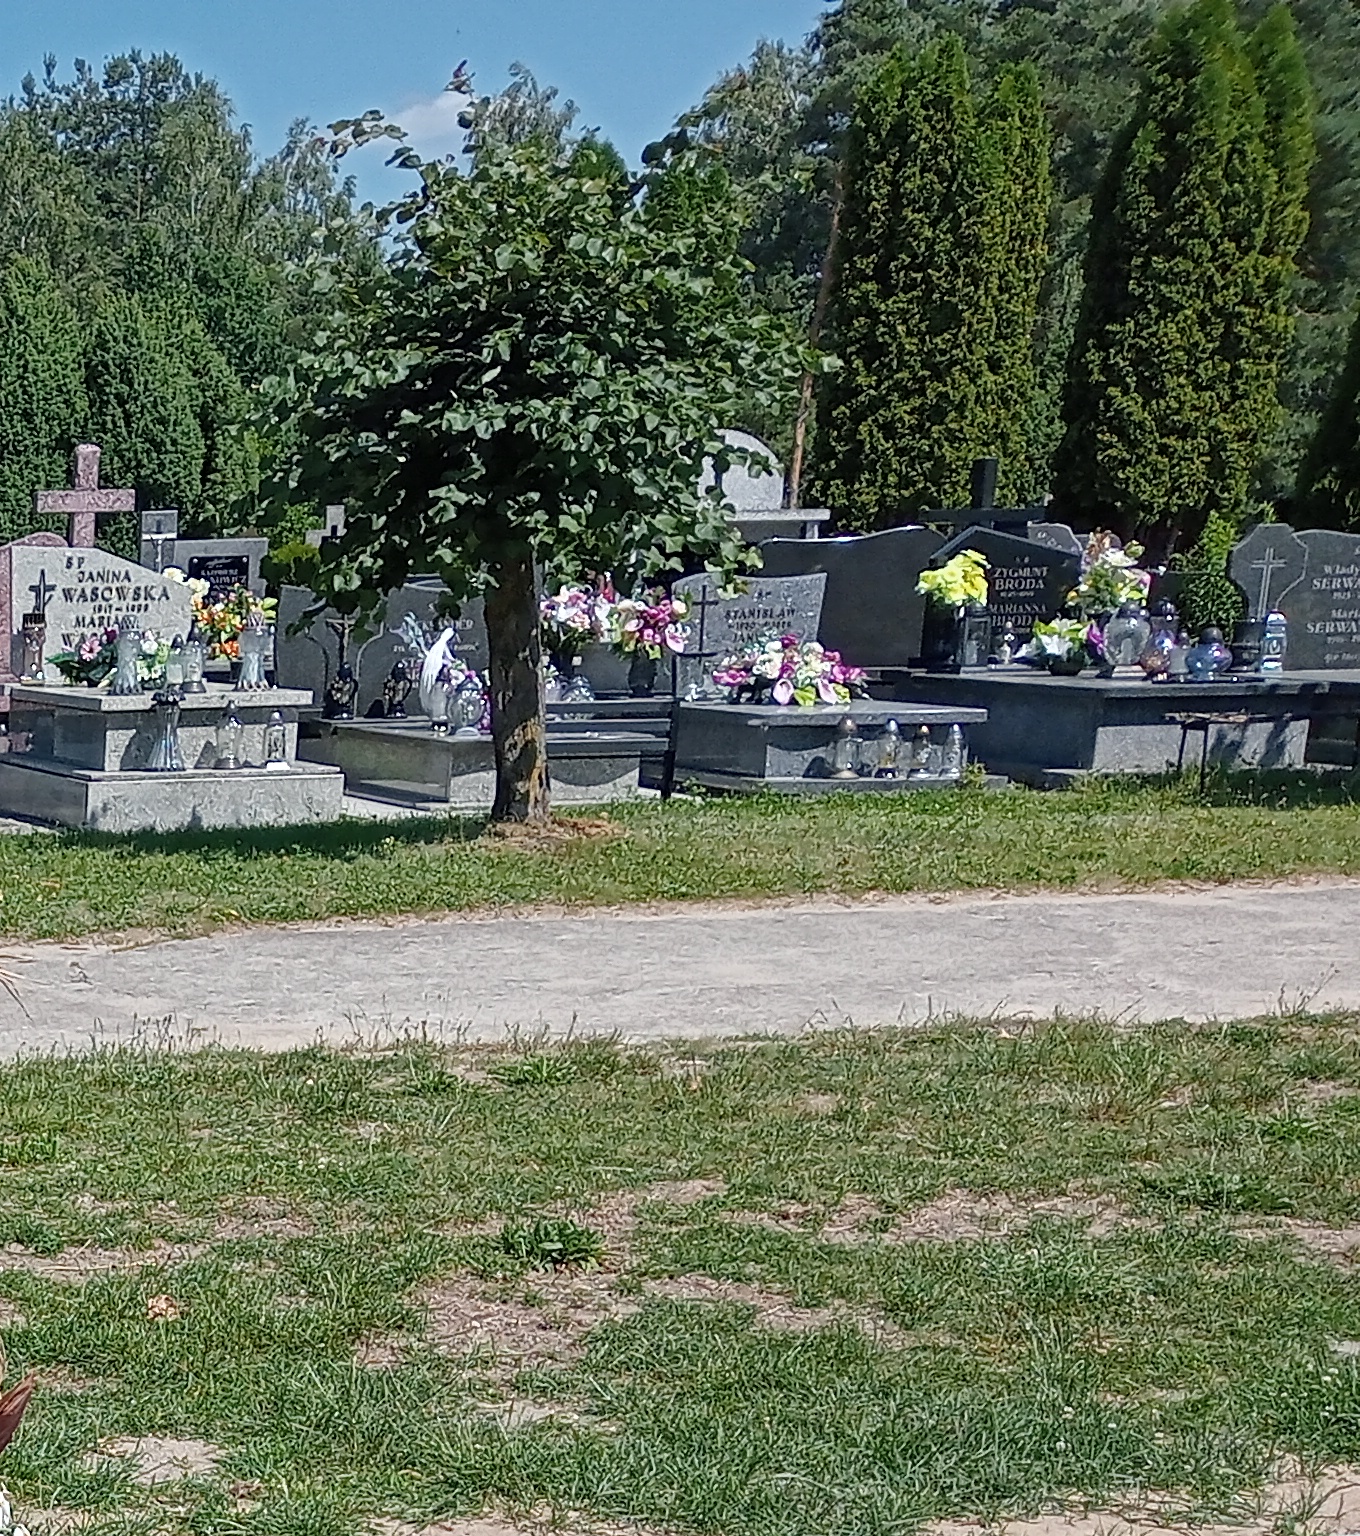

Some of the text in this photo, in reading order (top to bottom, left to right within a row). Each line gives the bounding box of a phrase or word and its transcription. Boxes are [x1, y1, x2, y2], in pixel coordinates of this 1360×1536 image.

[78, 568, 132, 583] JANINA
[994, 567, 1048, 578] ZYGMUNT
[995, 579, 1045, 591] BRODA
